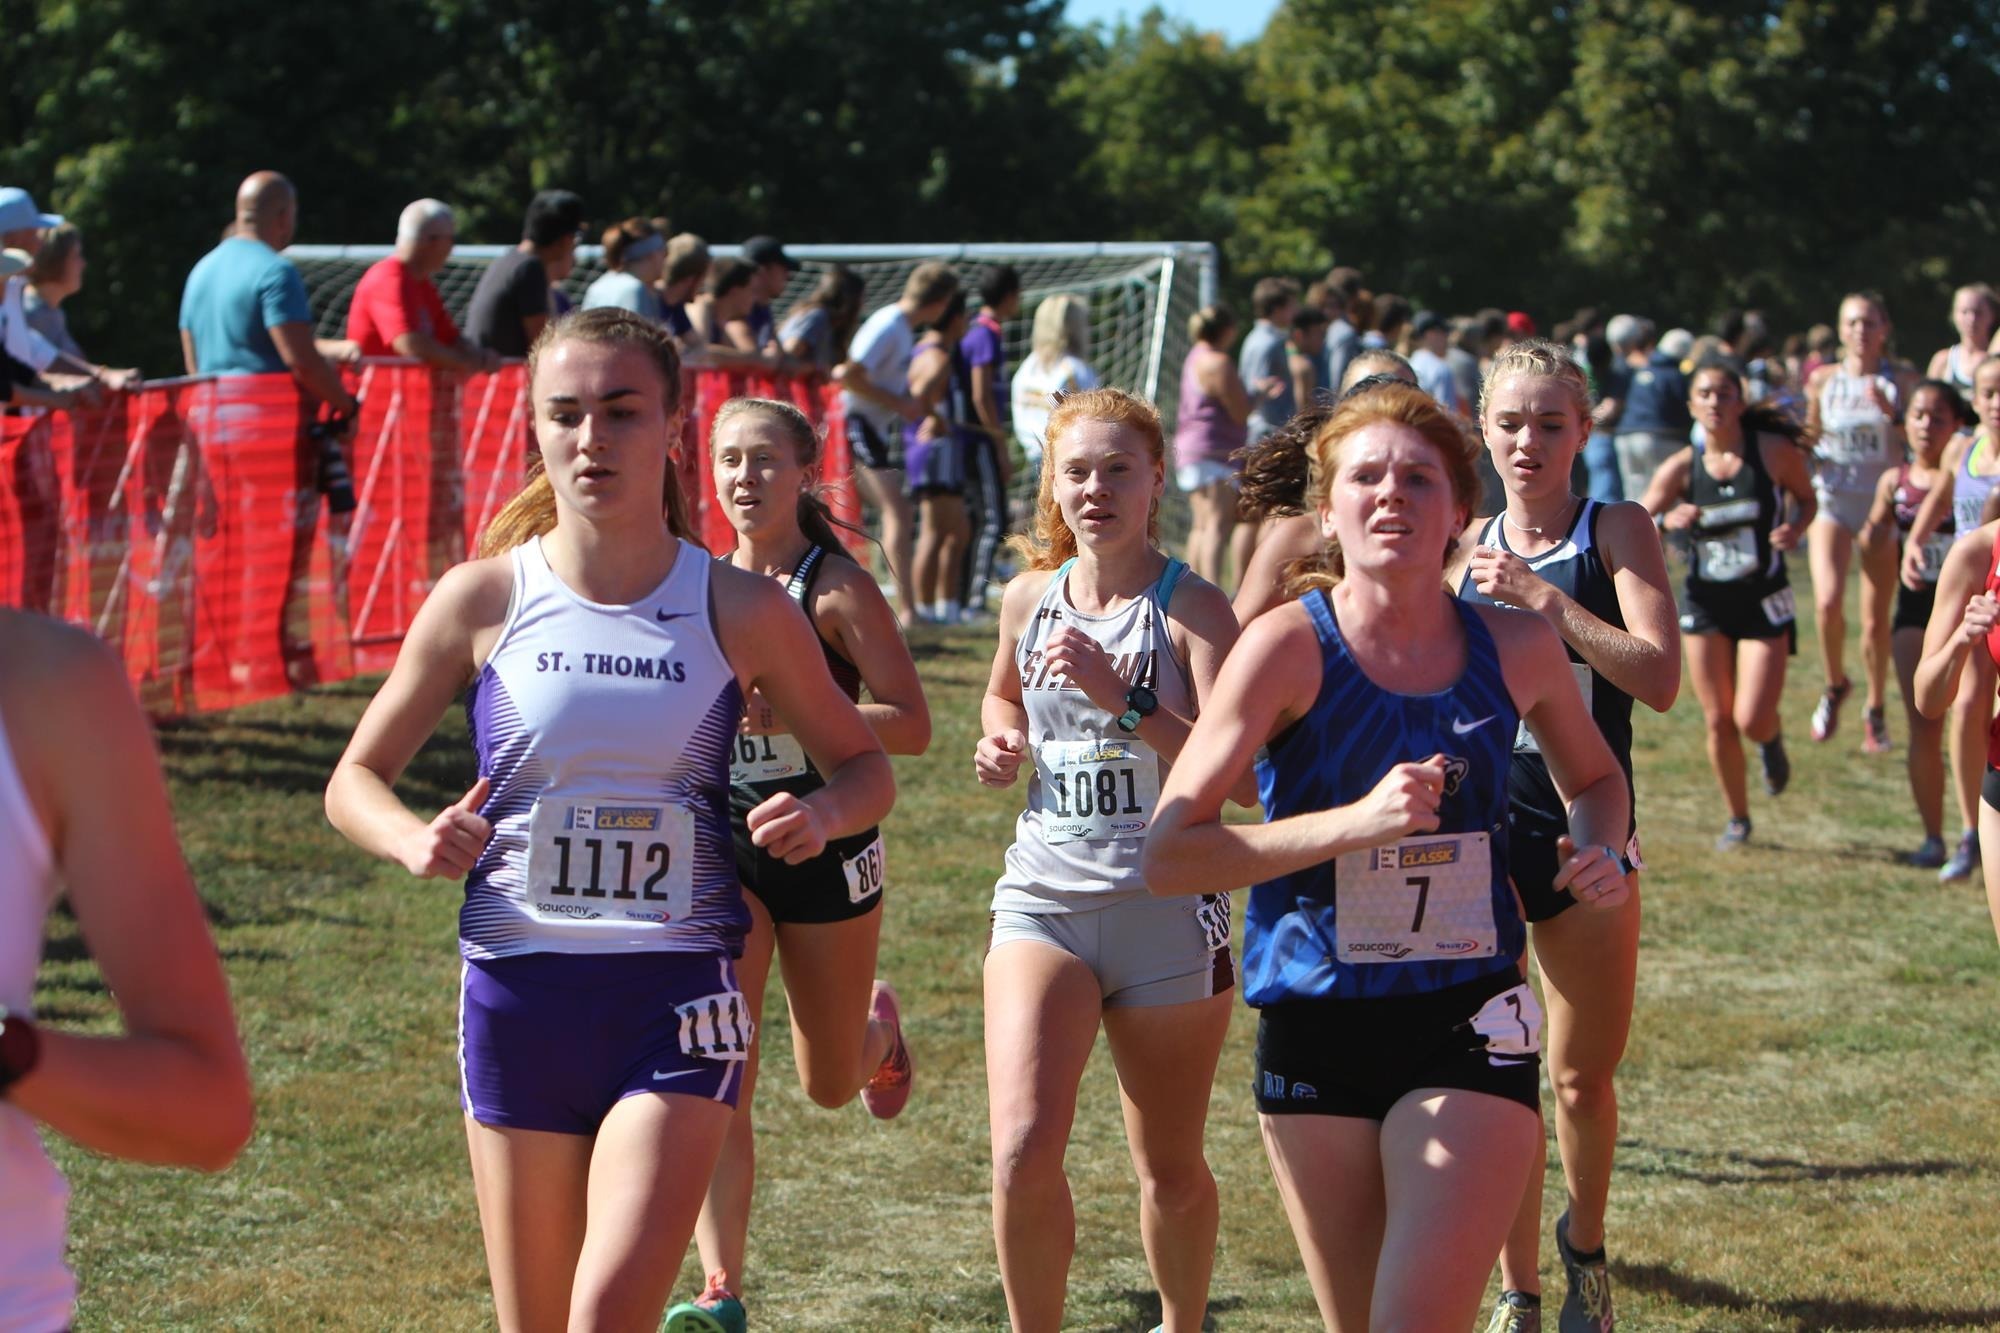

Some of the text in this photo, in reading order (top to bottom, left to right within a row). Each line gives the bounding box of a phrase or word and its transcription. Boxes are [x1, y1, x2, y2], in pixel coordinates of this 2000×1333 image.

[536, 652, 686, 682] ST. THOMAS
[1081, 749, 1124, 761] CLASSIC
[1054, 768, 1142, 818] 1081
[597, 815, 655, 829] CLASSIC
[1049, 823, 1084, 833] saucony
[1402, 848, 1454, 866] CLASSIC
[551, 836, 670, 901] 1112
[536, 902, 590, 915] saucony
[1406, 876, 1430, 932] 7
[1348, 942, 1401, 953] saucony
[1503, 993, 1530, 1047] 7
